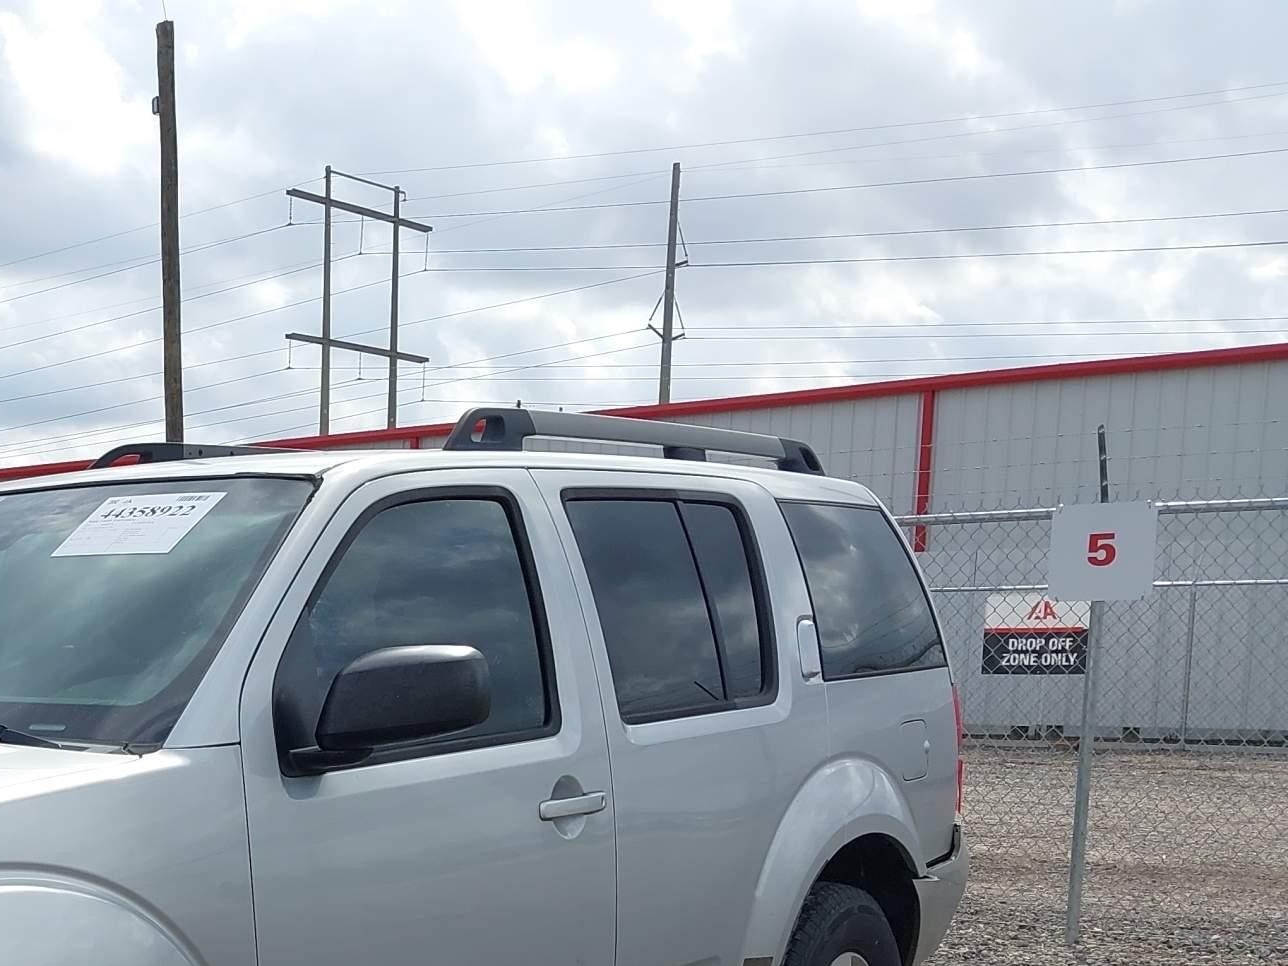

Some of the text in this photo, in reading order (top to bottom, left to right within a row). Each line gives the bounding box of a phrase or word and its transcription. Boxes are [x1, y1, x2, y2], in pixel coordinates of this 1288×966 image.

[100, 504, 197, 520] 44358922
[1087, 532, 1117, 567] 5
[1008, 637, 1074, 651] DROP OFF
[1001, 652, 1078, 666] ZONE ONLY
